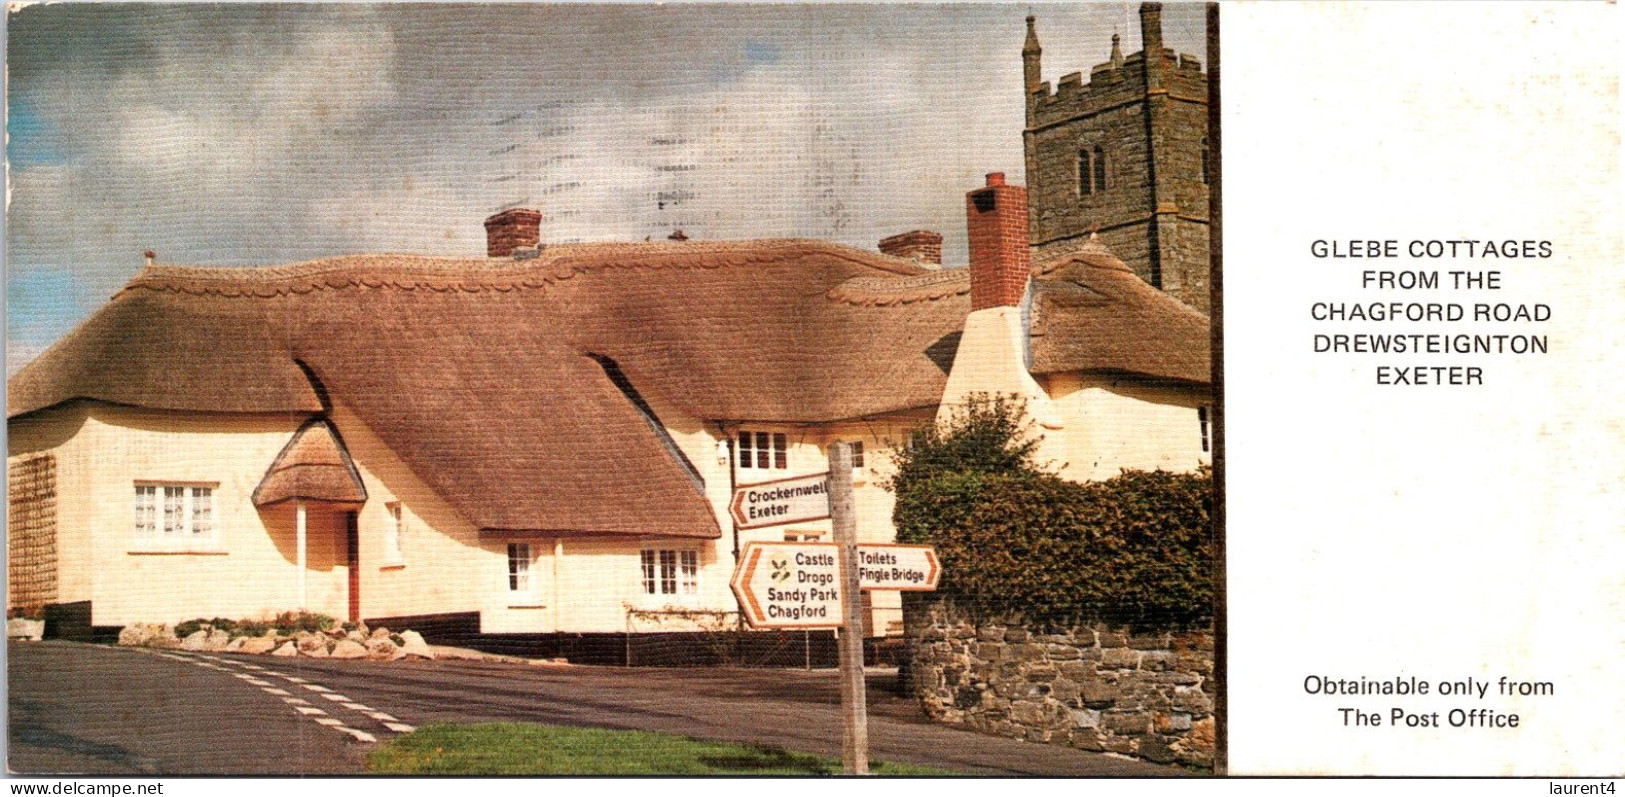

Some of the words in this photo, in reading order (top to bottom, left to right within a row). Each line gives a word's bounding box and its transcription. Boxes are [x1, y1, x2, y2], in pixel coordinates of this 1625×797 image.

[1311, 240, 1398, 258] GLEBE
[1409, 240, 1553, 258] COTTAGES
[1362, 271, 1439, 289] FROM
[1449, 271, 1501, 289] THE
[1311, 302, 1464, 321] CHAGFORD
[1474, 303, 1551, 321] ROAD
[1314, 334, 1548, 353] DREWSTEIGNTON
[1377, 366, 1483, 385] EXETER
[748, 481, 829, 503] Crockernwell
[749, 502, 789, 519] Exeter
[795, 552, 834, 566] Castle
[860, 551, 897, 564] Toilets
[798, 570, 833, 585] Drogo
[859, 567, 889, 583] Fingle
[892, 568, 925, 582] Bridge
[767, 588, 807, 602] Sandy
[810, 588, 838, 601] Park
[768, 604, 827, 620] Chagford
[1304, 675, 1429, 695] Obtainable
[1438, 677, 1489, 699] only
[1498, 676, 1554, 695] from
[1338, 708, 1381, 726] The
[1391, 708, 1439, 727] Post
[1448, 708, 1520, 728] Office
